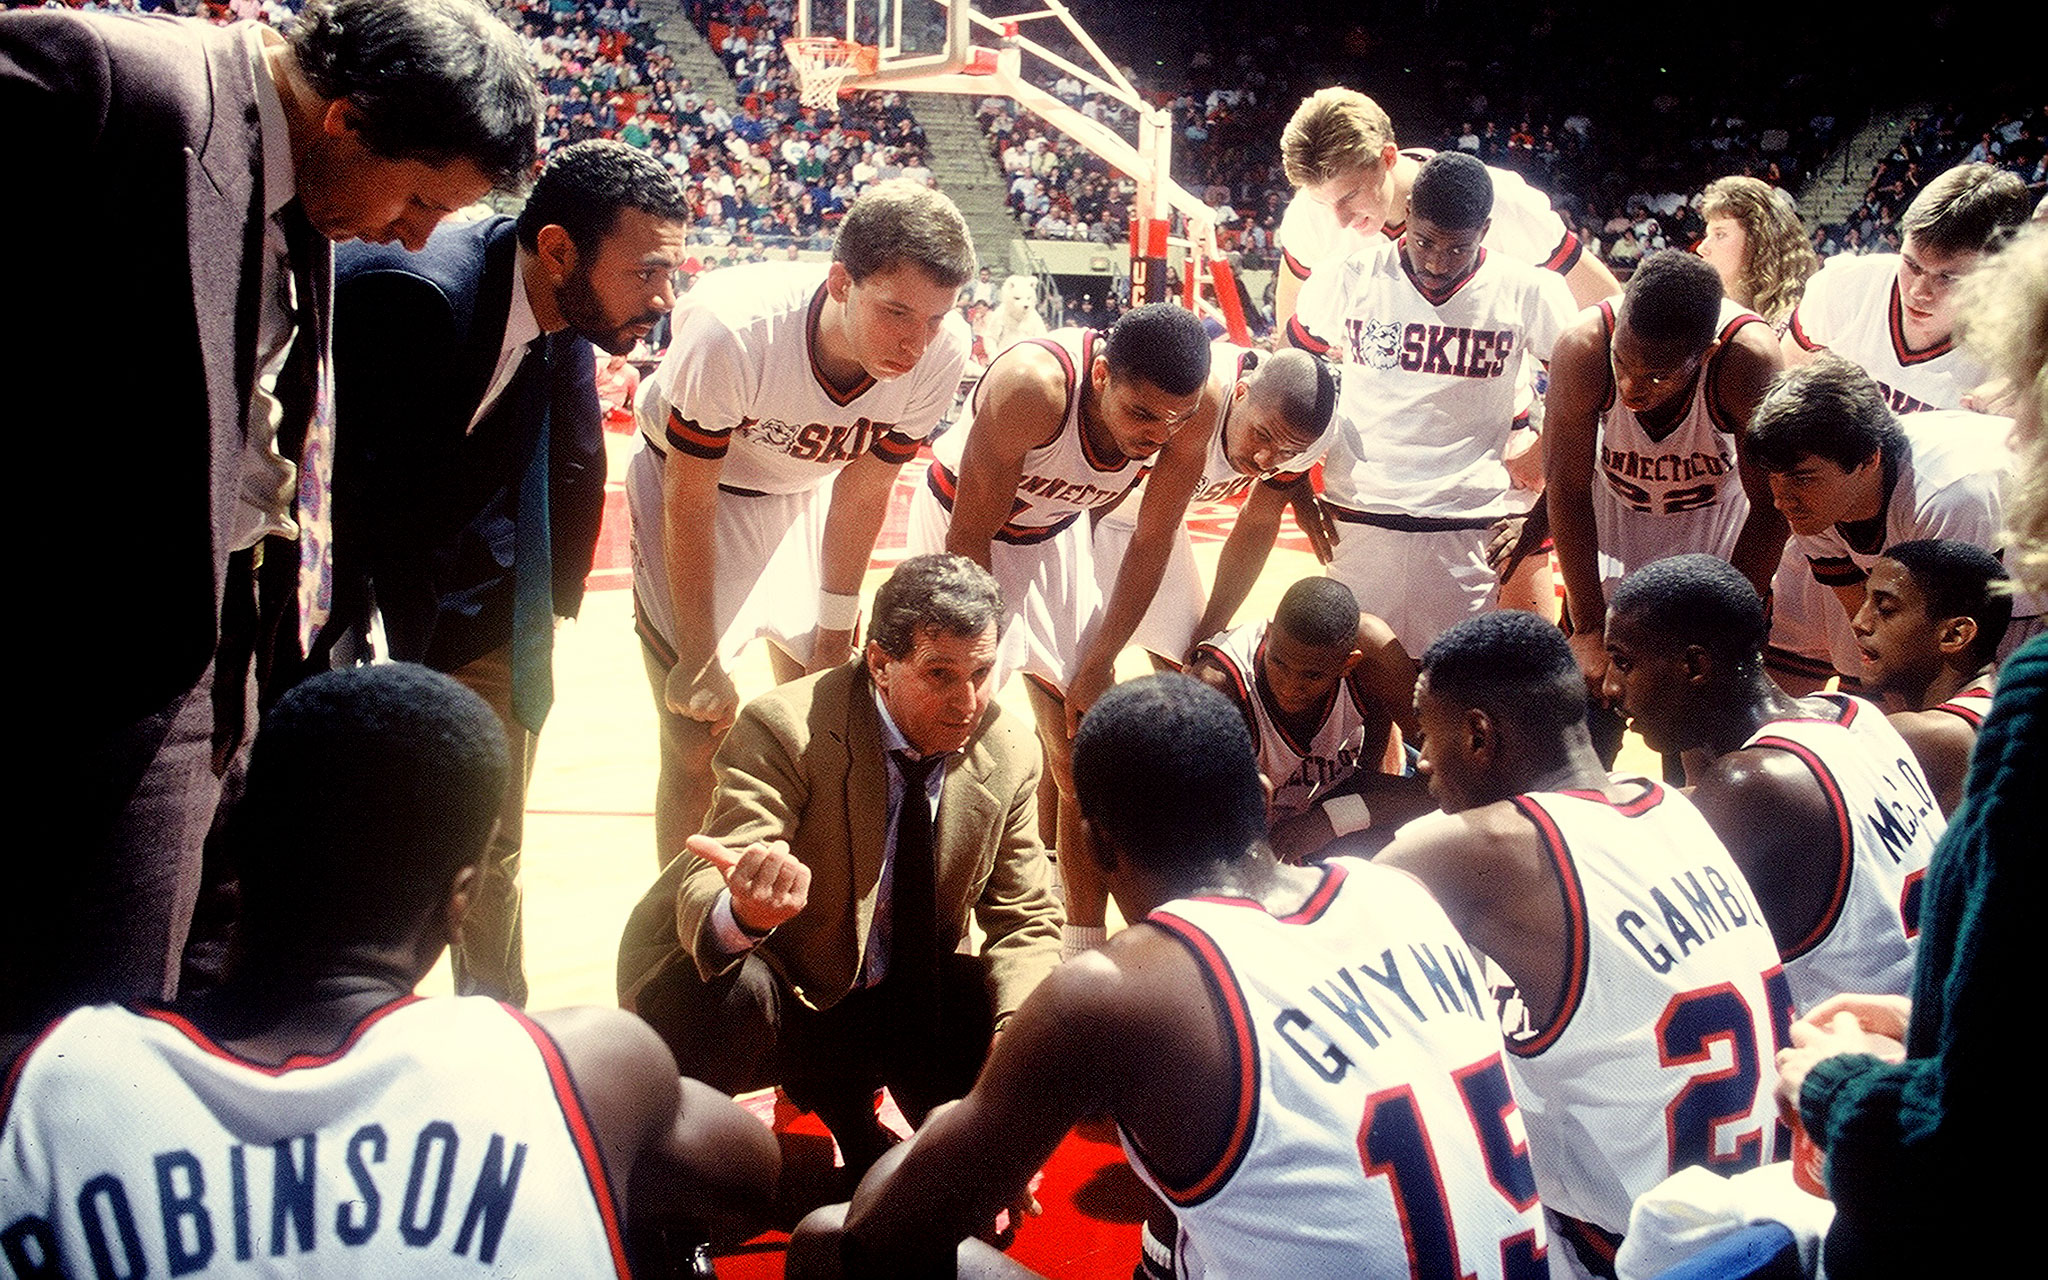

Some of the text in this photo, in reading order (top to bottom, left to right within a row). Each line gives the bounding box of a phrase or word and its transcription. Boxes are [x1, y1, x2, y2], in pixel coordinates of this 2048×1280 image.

[1273, 943, 1486, 1084] GWYNN
[0, 1120, 527, 1280] ROBINSON
[1356, 1050, 1550, 1280] 15
